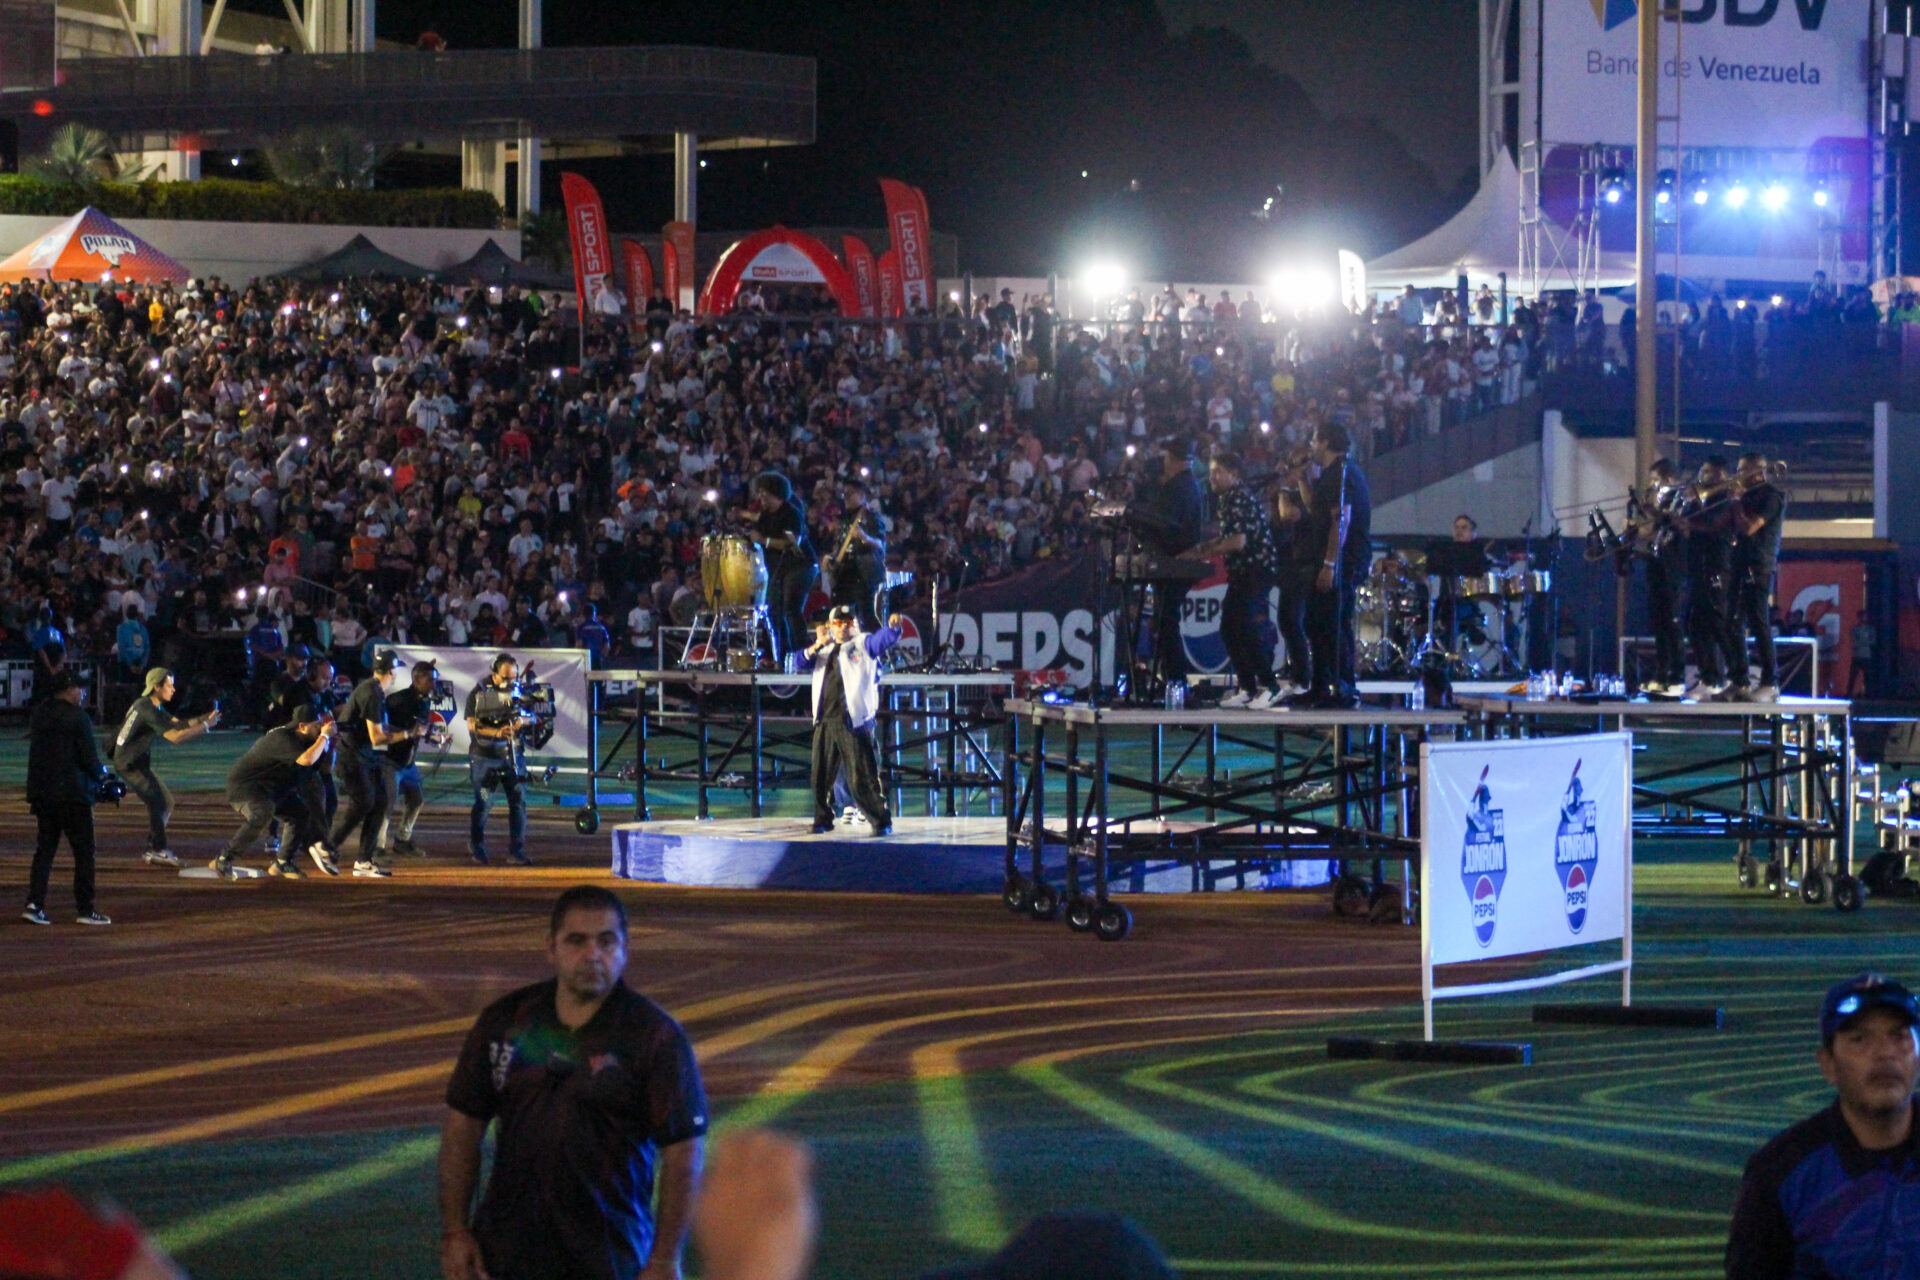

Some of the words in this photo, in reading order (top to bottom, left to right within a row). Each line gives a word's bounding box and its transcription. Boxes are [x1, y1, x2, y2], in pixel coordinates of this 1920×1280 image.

[1586, 50, 1639, 75] Banc
[1664, 56, 1692, 79] de
[1698, 56, 1821, 85] Venezuela
[81, 235, 131, 251] POLAR
[580, 210, 601, 272] SPORT
[901, 216, 920, 278] SPORT
[1181, 598, 1220, 623] PEP
[938, 609, 1116, 690] PEPSI
[1474, 903, 1495, 918] PEPSI
[1567, 891, 1587, 906] PEPSI
